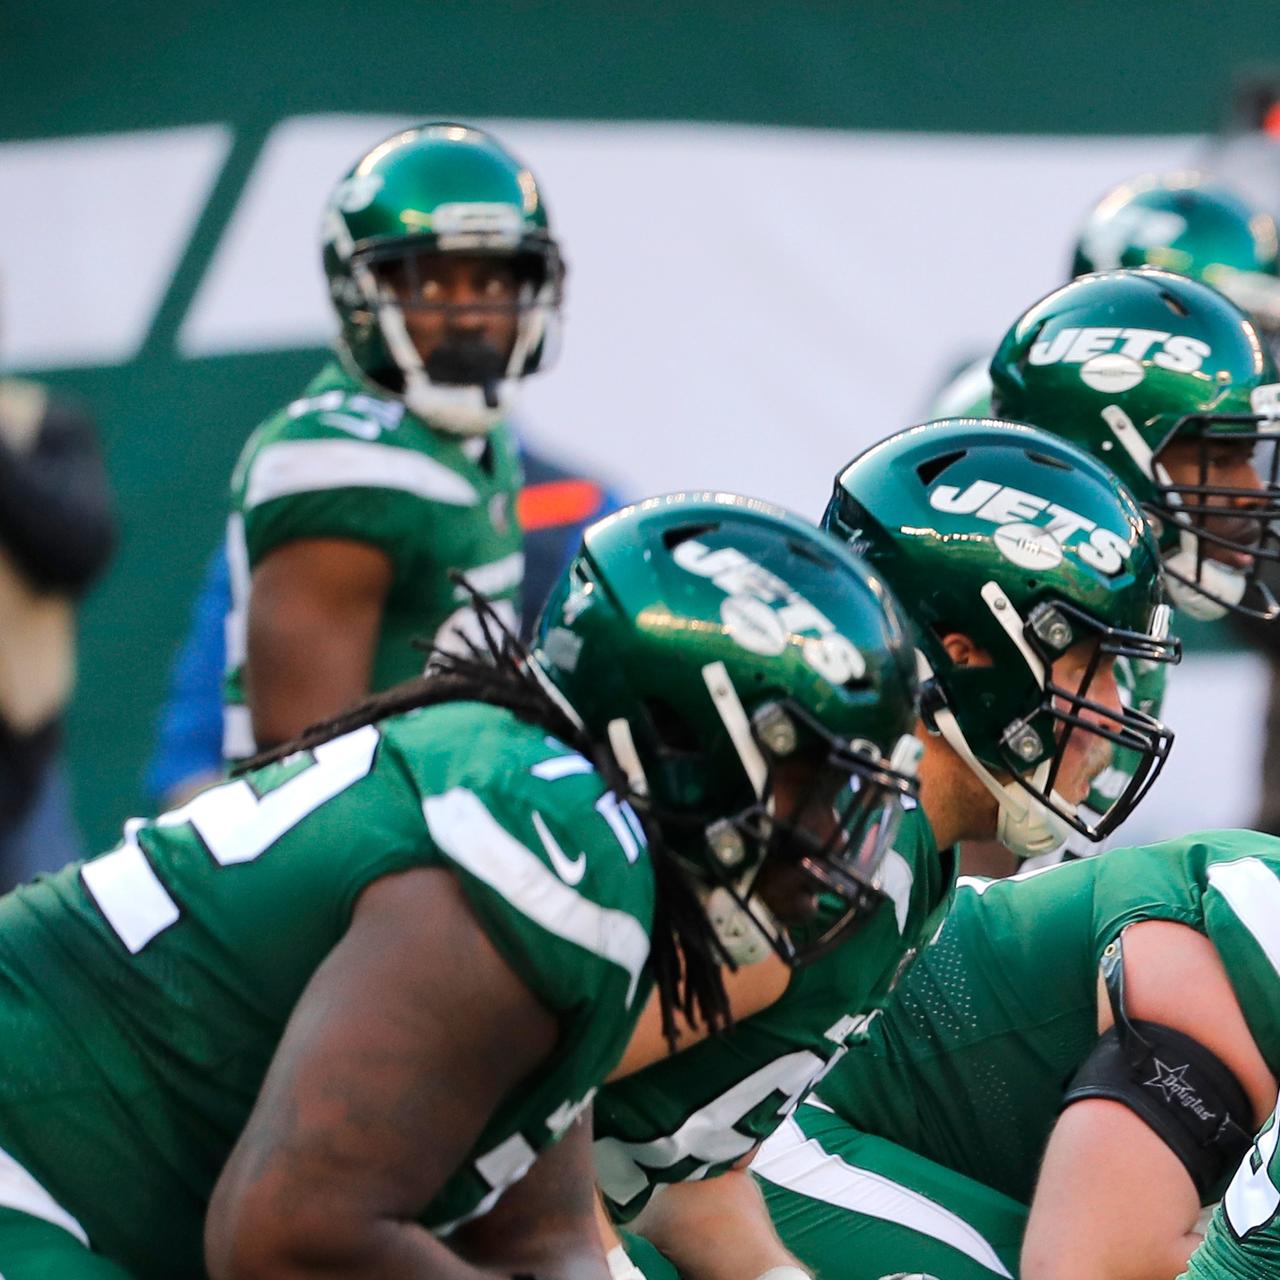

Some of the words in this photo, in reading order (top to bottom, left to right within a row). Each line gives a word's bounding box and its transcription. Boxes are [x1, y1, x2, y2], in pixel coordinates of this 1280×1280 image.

[1027, 327, 1212, 374] JETS
[929, 479, 1132, 575] JETS
[672, 539, 867, 686] JETS
[1161, 1073, 1217, 1121] Douglas
